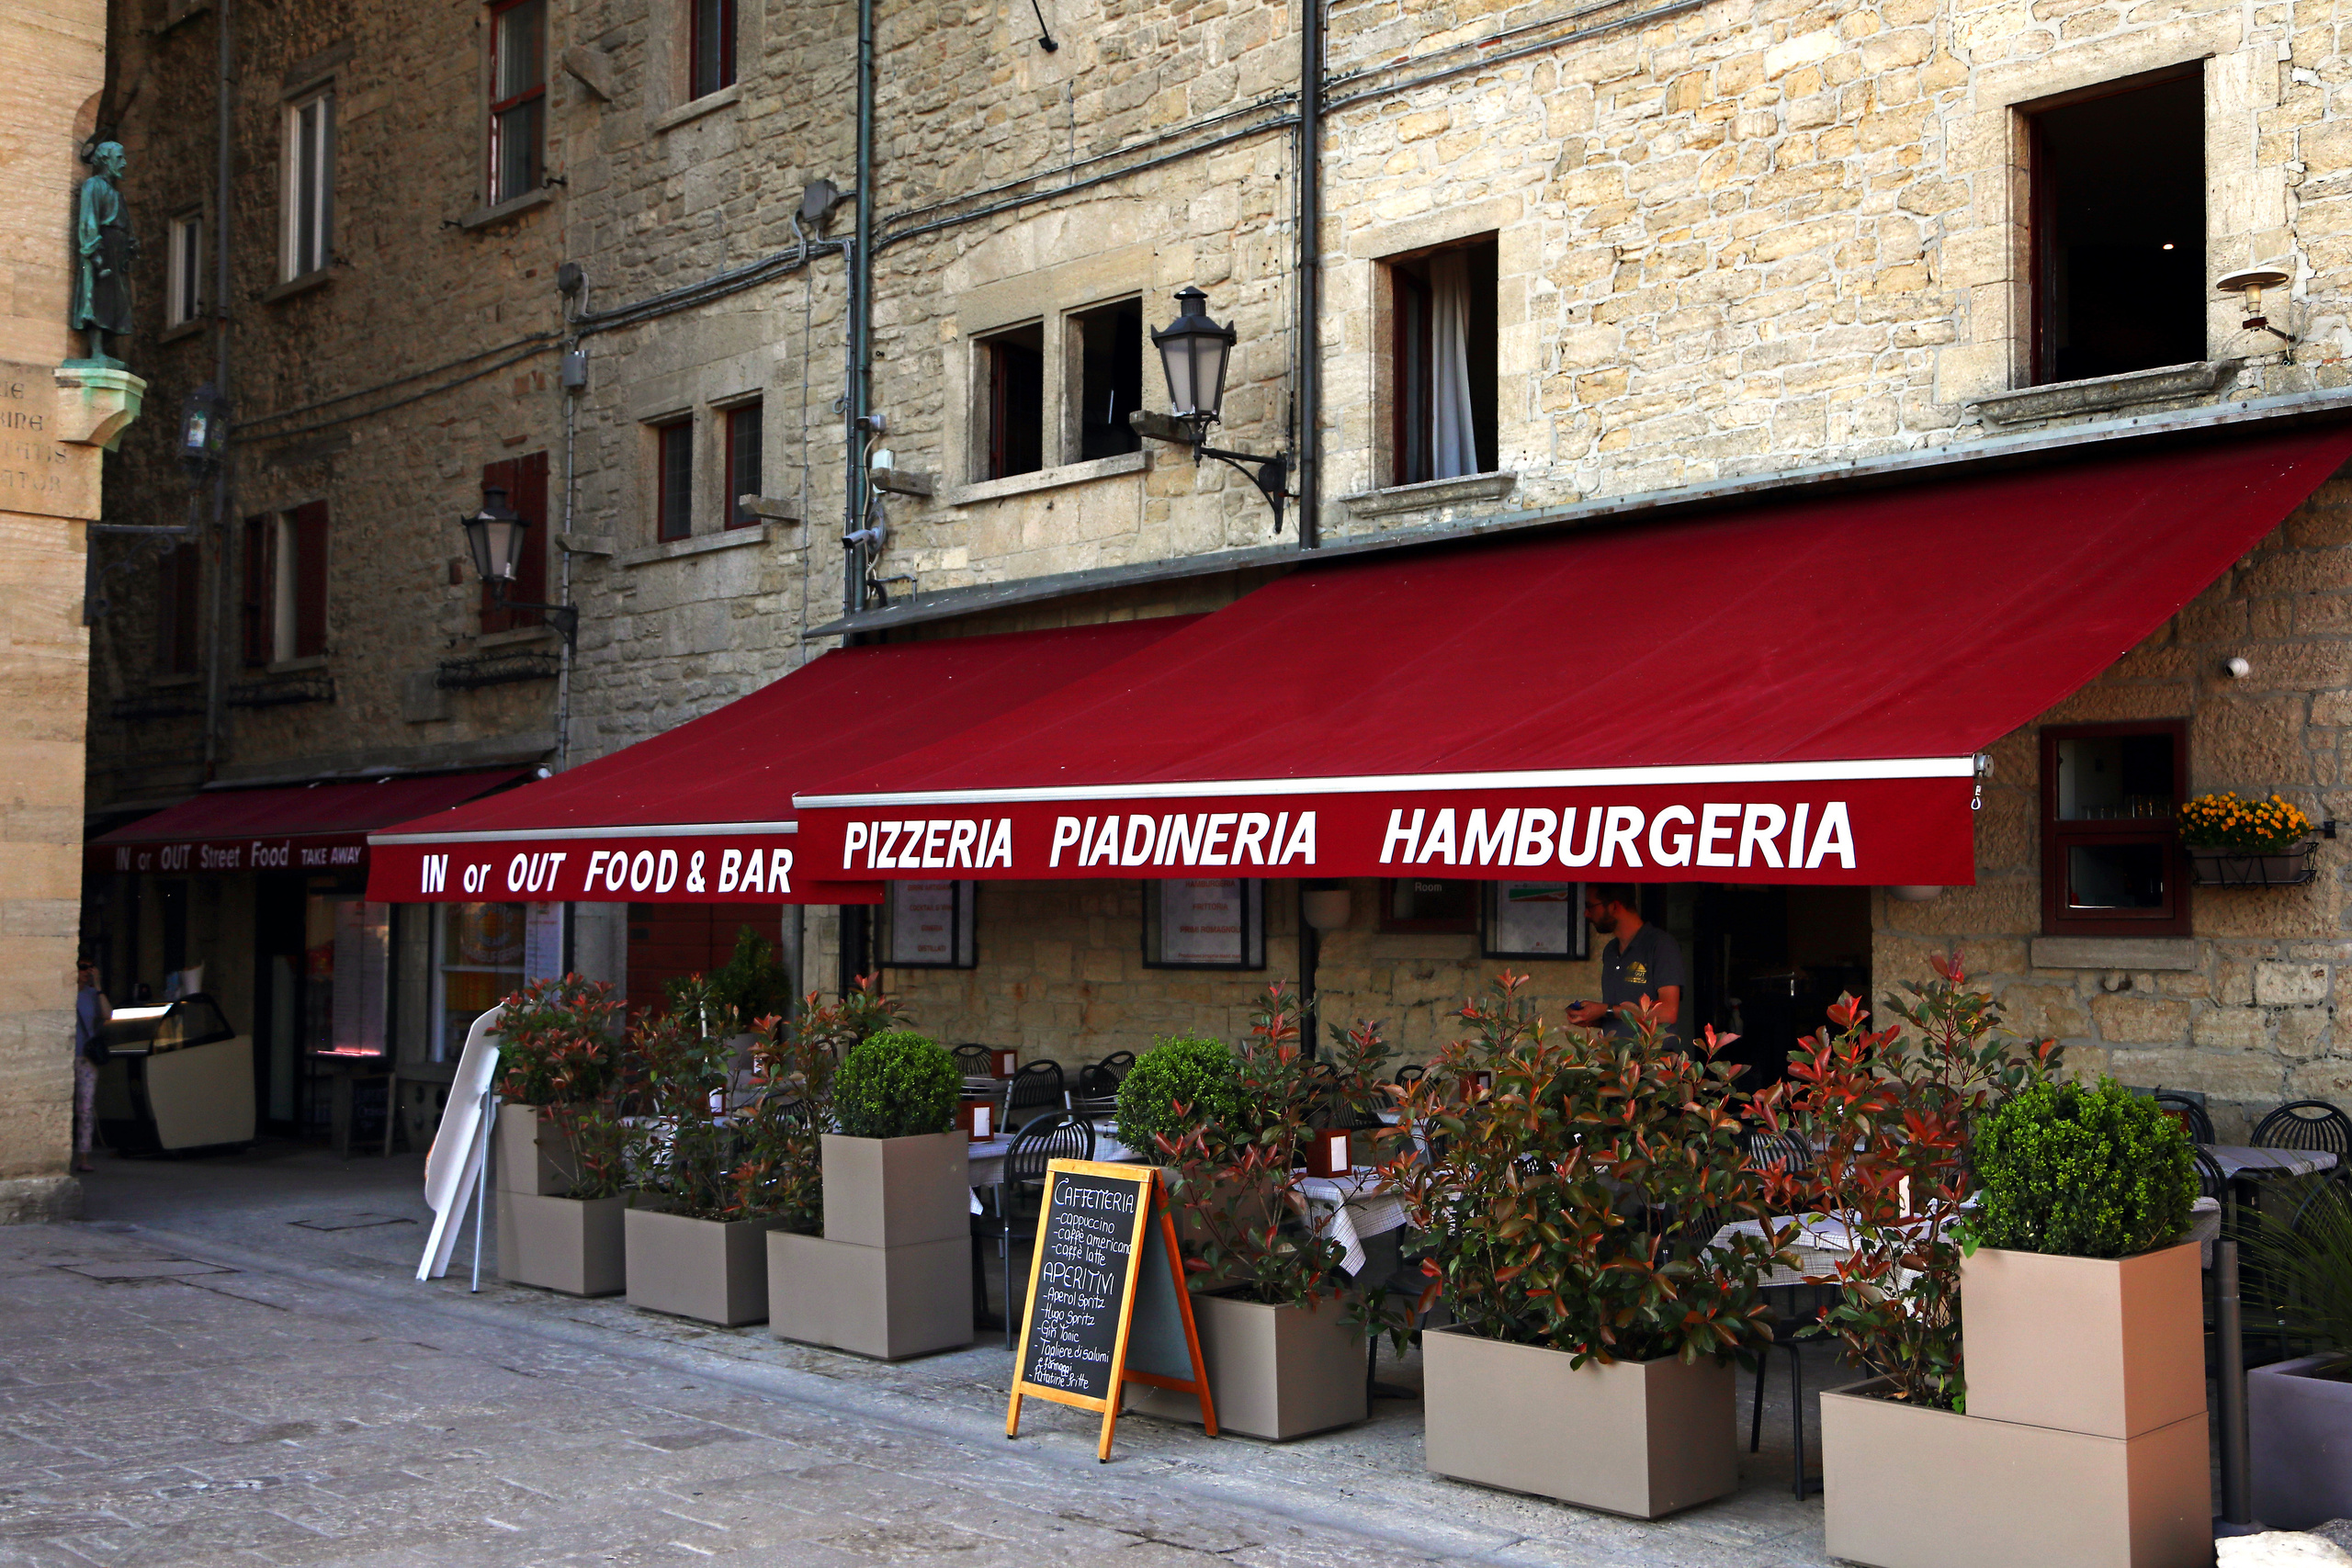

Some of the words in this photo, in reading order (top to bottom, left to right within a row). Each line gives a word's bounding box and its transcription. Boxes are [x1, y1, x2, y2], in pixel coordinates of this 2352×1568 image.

[843, 818, 1012, 870] PIZZERIA
[1049, 810, 1317, 868] PIADINERIA
[1379, 801, 1857, 869] HAMBURGERIA
[115, 846, 130, 872] IN
[137, 852, 152, 871] or
[160, 844, 191, 870] OUT
[200, 844, 241, 869] Street
[251, 840, 290, 868] Food
[300, 848, 327, 865] TAKE
[330, 846, 362, 864] AWAY
[421, 854, 448, 893] IN
[463, 863, 491, 893] or
[507, 852, 567, 892] OUT
[583, 850, 679, 893] FOOD
[686, 850, 706, 893] &
[718, 848, 794, 894] BAR
[1185, 880, 1235, 888] HAMBURGERIA
[1415, 882, 1442, 892] Room
[1055, 1178, 1134, 1213] CAFFETTERIA
[1086, 1247, 1106, 1266] latte
[1044, 1261, 1114, 1295] APERITIVI
[1078, 1293, 1105, 1310] Spritz
[1066, 1310, 1095, 1325] Spritz
[1059, 1324, 1080, 1343] Tonic
[1040, 1337, 1073, 1361] Tagliere
[1074, 1344, 1082, 1359] di
[1082, 1347, 1110, 1363] salumi
[1034, 1365, 1065, 1387] Patatine
